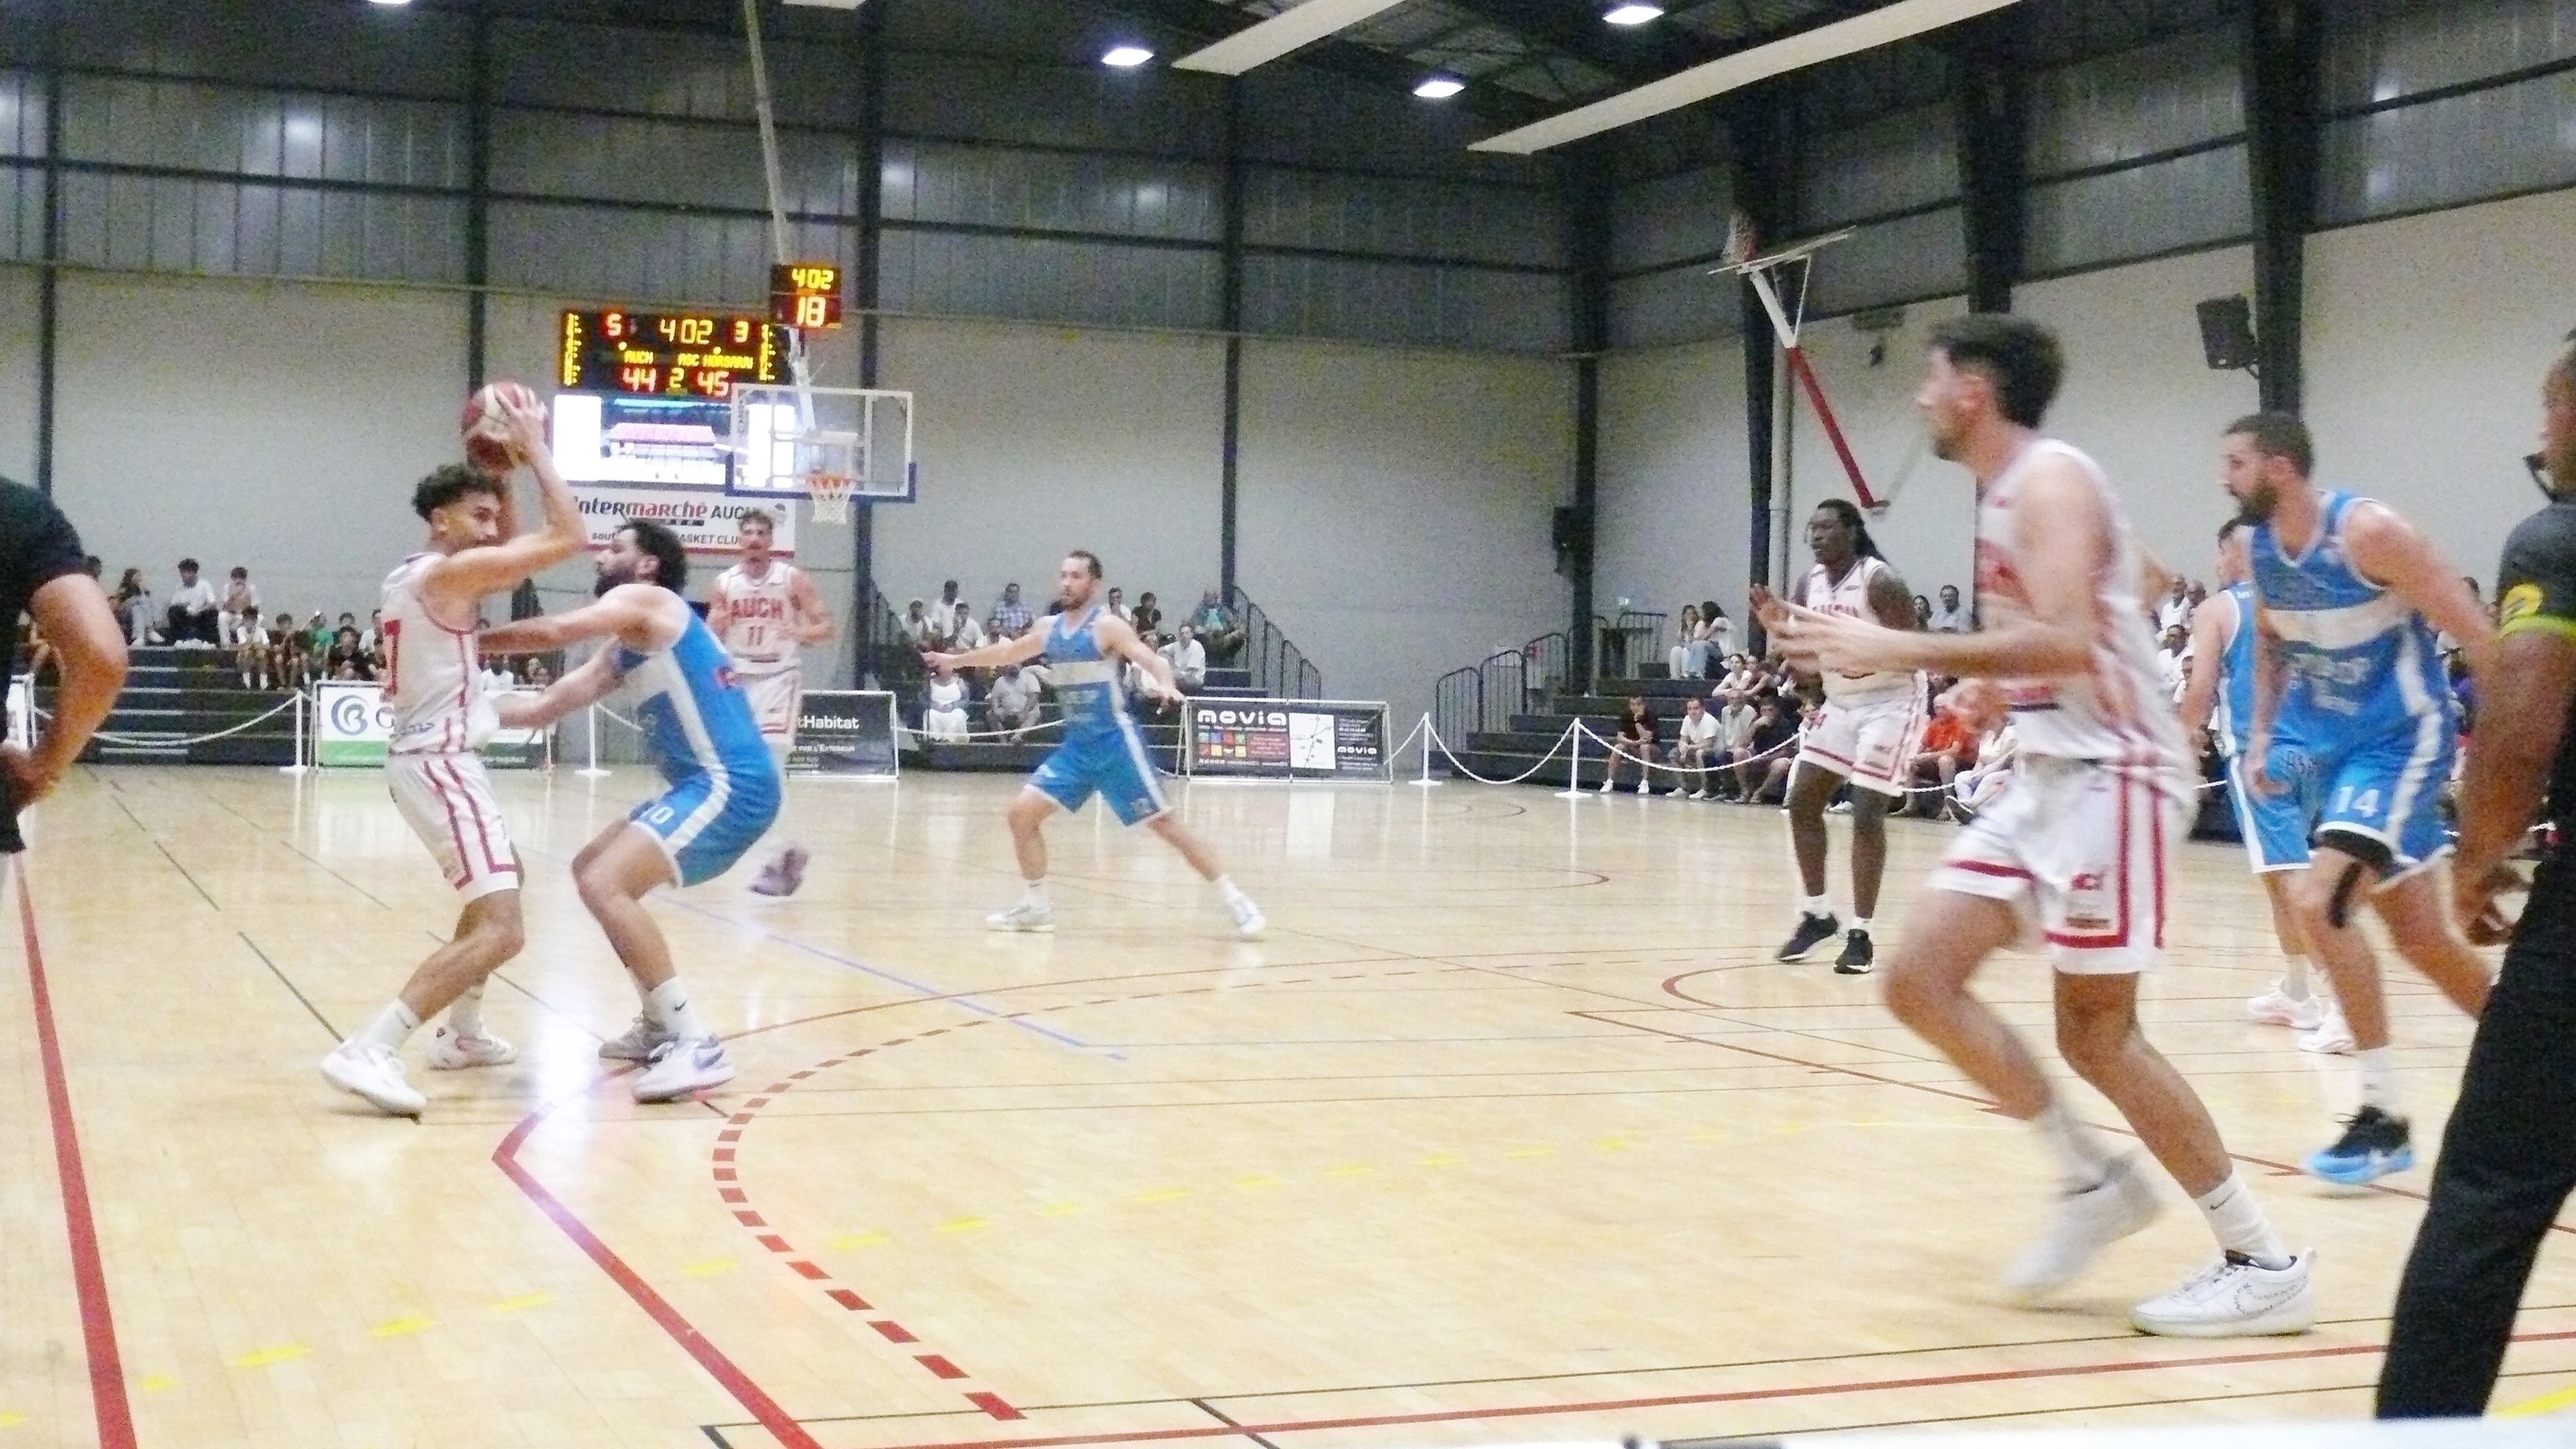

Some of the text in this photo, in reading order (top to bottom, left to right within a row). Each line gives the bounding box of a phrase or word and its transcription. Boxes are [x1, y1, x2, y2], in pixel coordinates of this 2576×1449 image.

[796, 296, 826, 328] 18
[607, 313, 622, 336] 5
[735, 321, 749, 343] 3
[624, 350, 654, 364] AUCH
[678, 353, 699, 367] ASC
[622, 367, 656, 392] 44
[668, 367, 684, 388] 2
[696, 371, 730, 396] 45
[678, 533, 739, 545] ASKET CLU
[731, 597, 783, 620] AUCH
[748, 625, 764, 646] 11
[1197, 709, 1287, 726] movia
[1337, 746, 1377, 755] movia
[2336, 785, 2380, 817] 14
